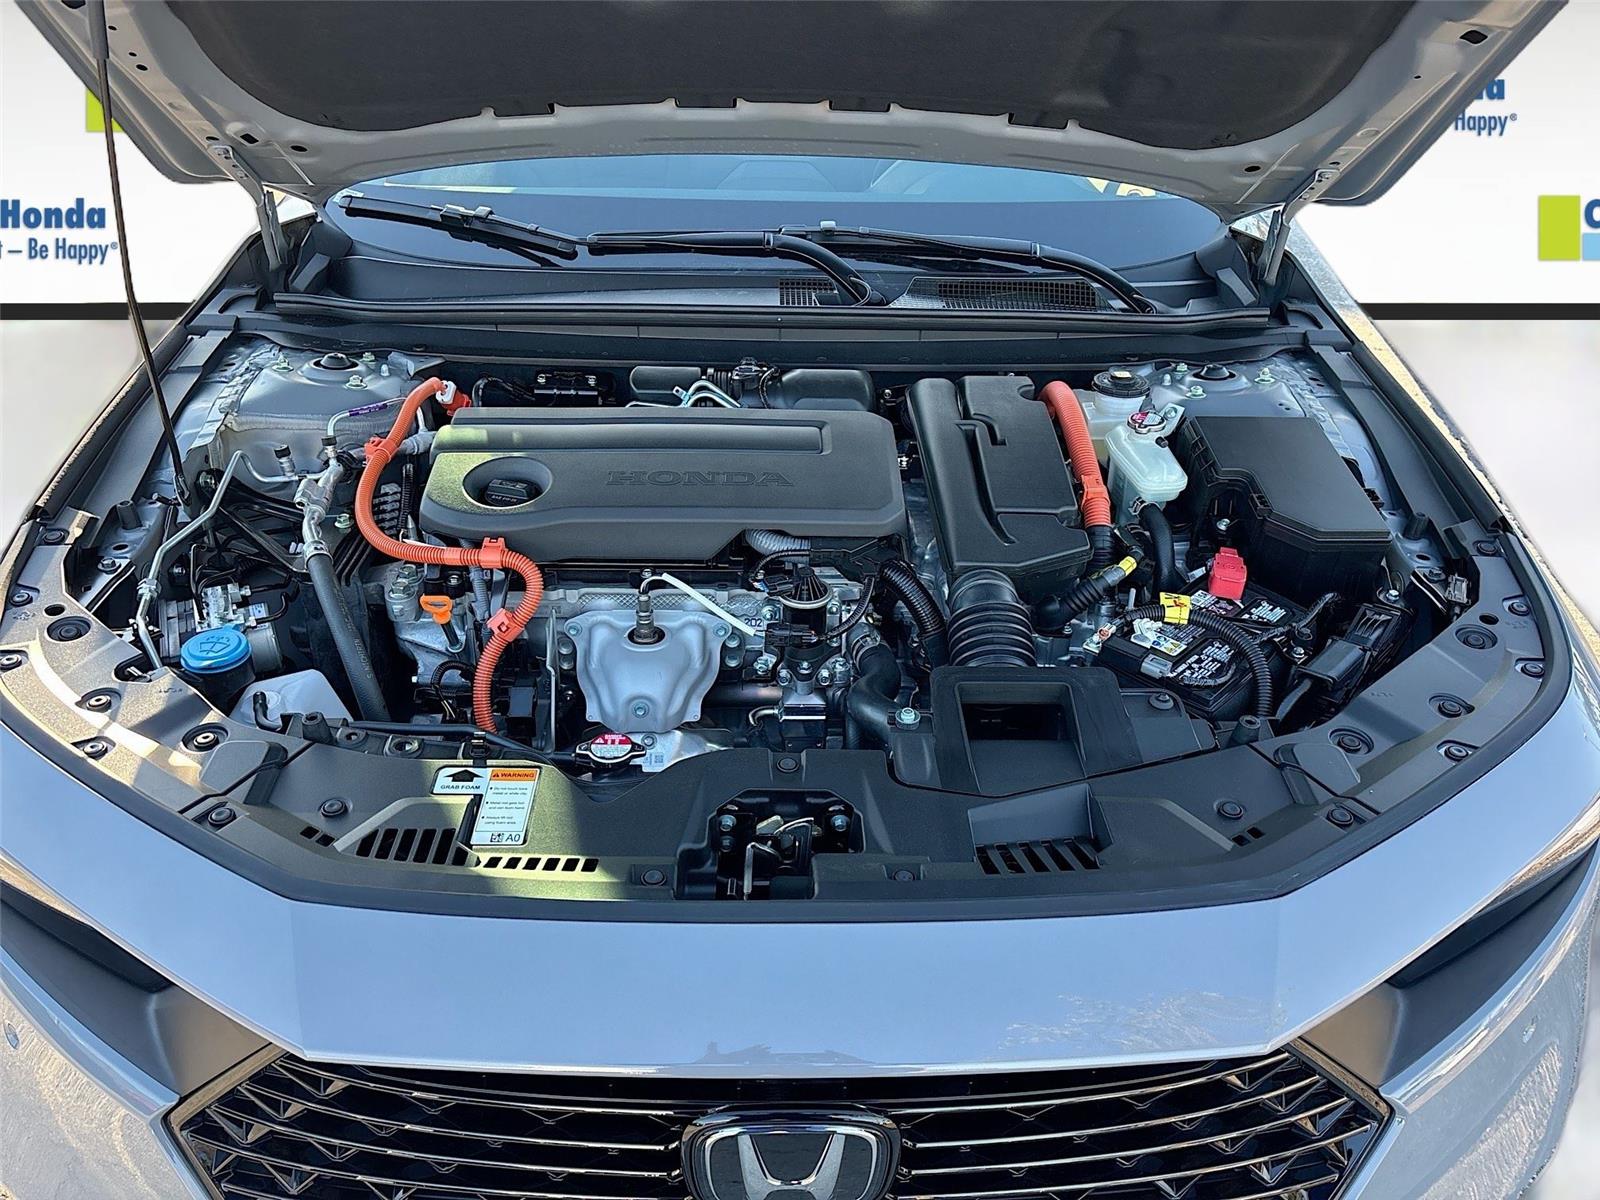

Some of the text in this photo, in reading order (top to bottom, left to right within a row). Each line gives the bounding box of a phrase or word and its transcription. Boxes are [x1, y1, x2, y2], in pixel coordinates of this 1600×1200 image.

[0, 197, 106, 229] Honda
[28, 237, 49, 260] Be
[606, 470, 793, 487] HONDA
[505, 833, 521, 843] A0
